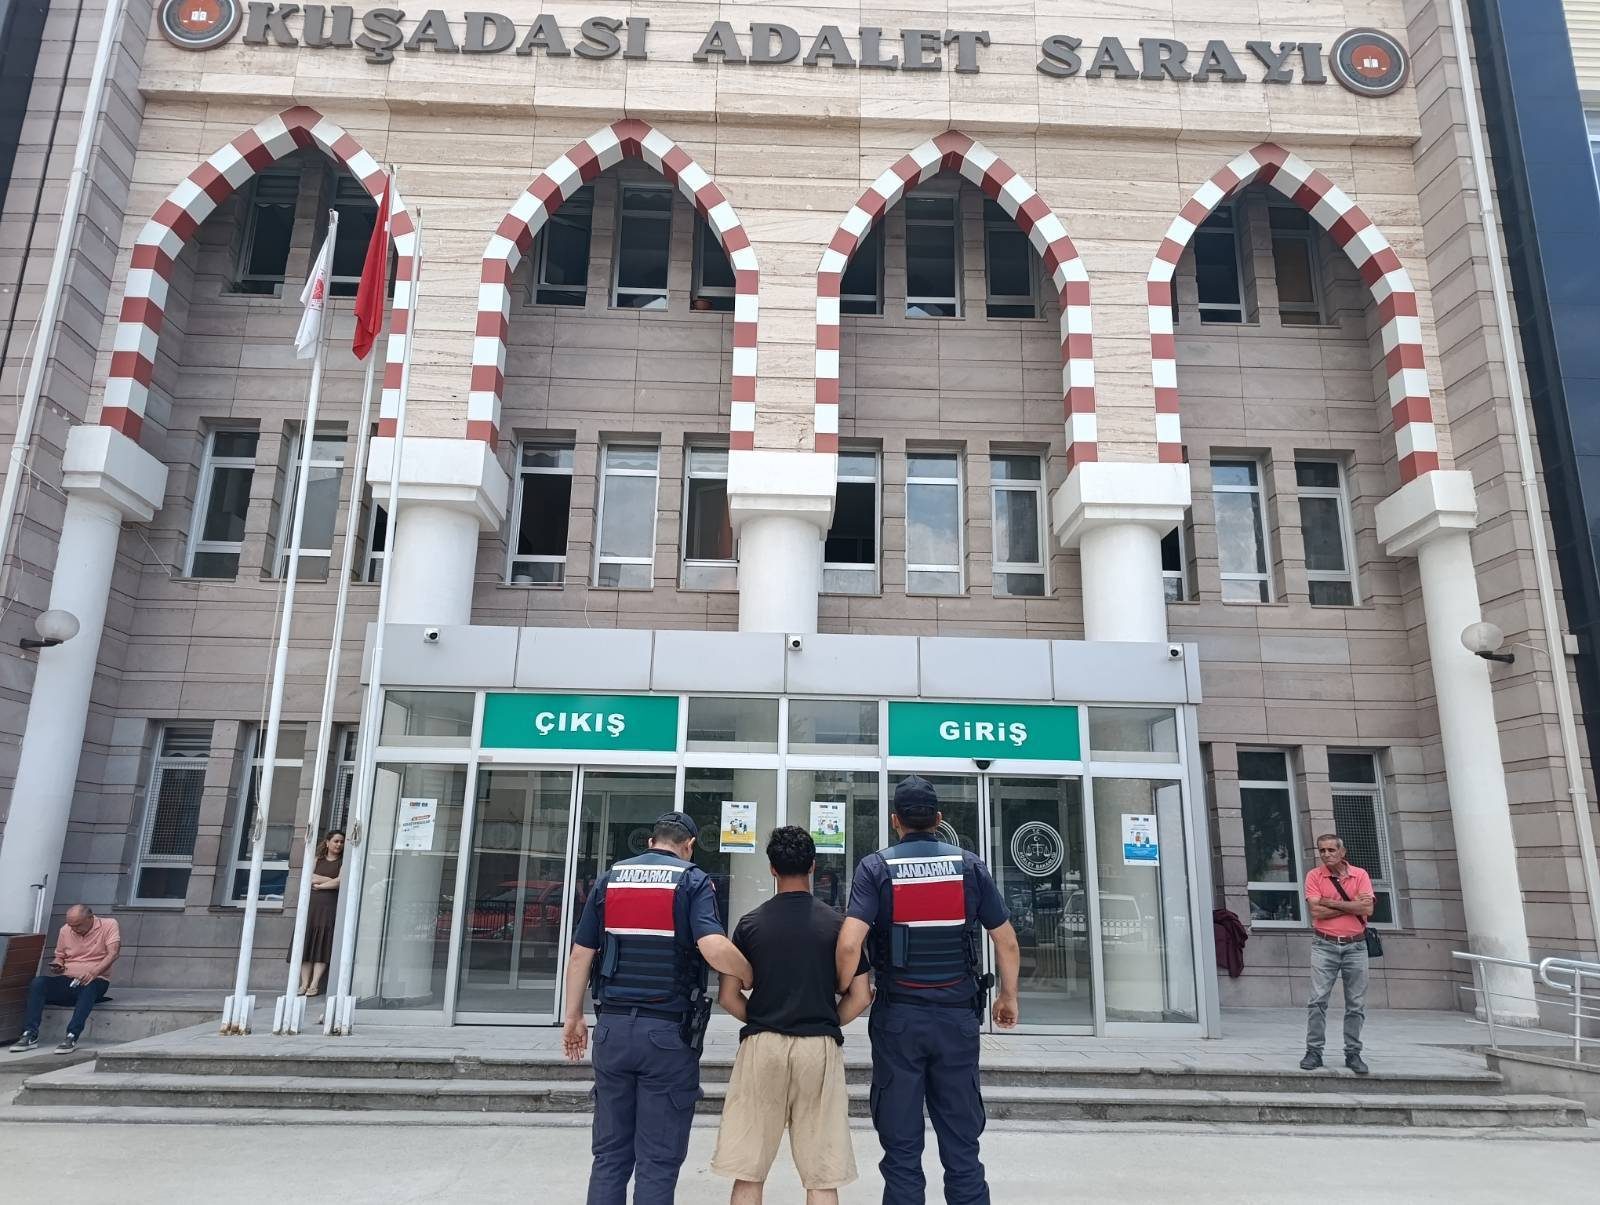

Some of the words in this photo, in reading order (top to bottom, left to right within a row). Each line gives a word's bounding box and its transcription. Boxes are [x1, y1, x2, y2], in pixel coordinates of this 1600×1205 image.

[243, 2, 649, 64] KUŞADASI
[693, 21, 990, 74] ADALET
[1037, 35, 1328, 83] SARAYI
[535, 711, 625, 737] ÇIKIŞ
[616, 869, 673, 883] JANDARMA
[896, 861, 957, 879] JANDARMA
